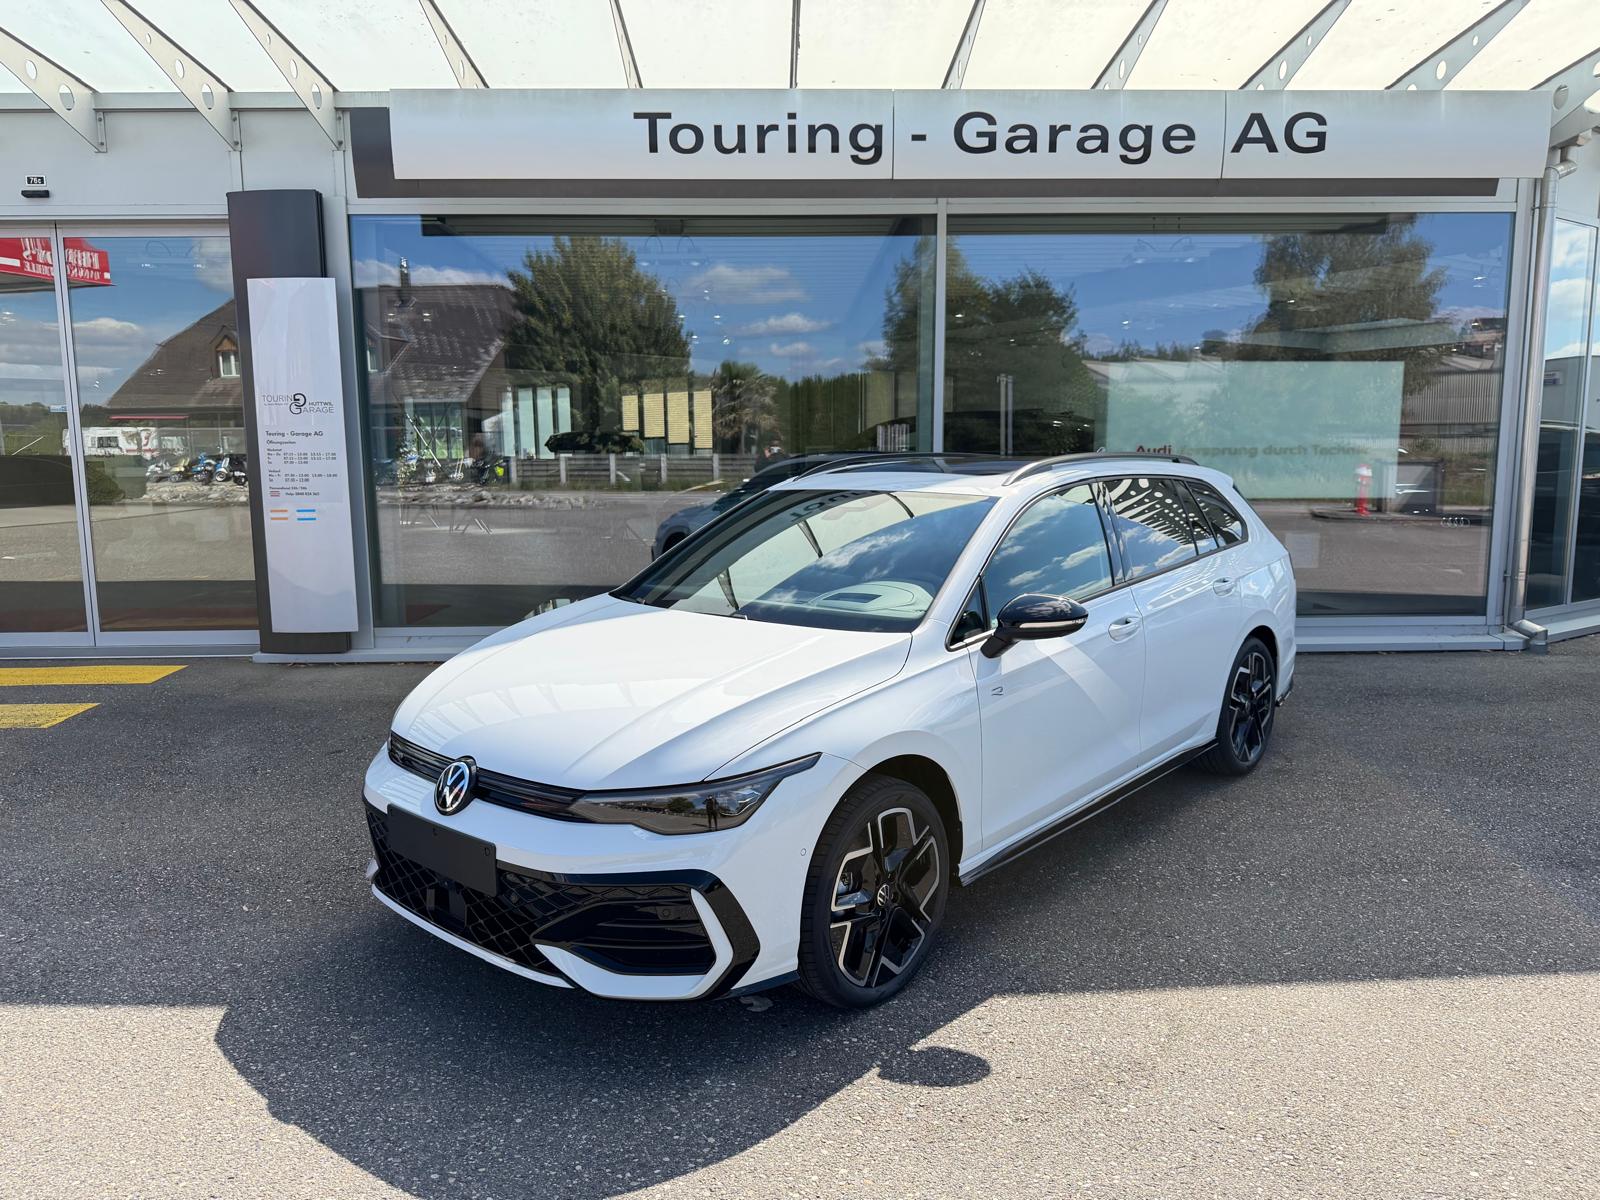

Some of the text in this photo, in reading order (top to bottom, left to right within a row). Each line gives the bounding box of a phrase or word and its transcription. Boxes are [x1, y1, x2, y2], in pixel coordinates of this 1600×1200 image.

[633, 111, 1327, 165] Touring - Garage AG
[290, 430, 312, 438] Garage
[1262, 444, 1307, 456] durch
